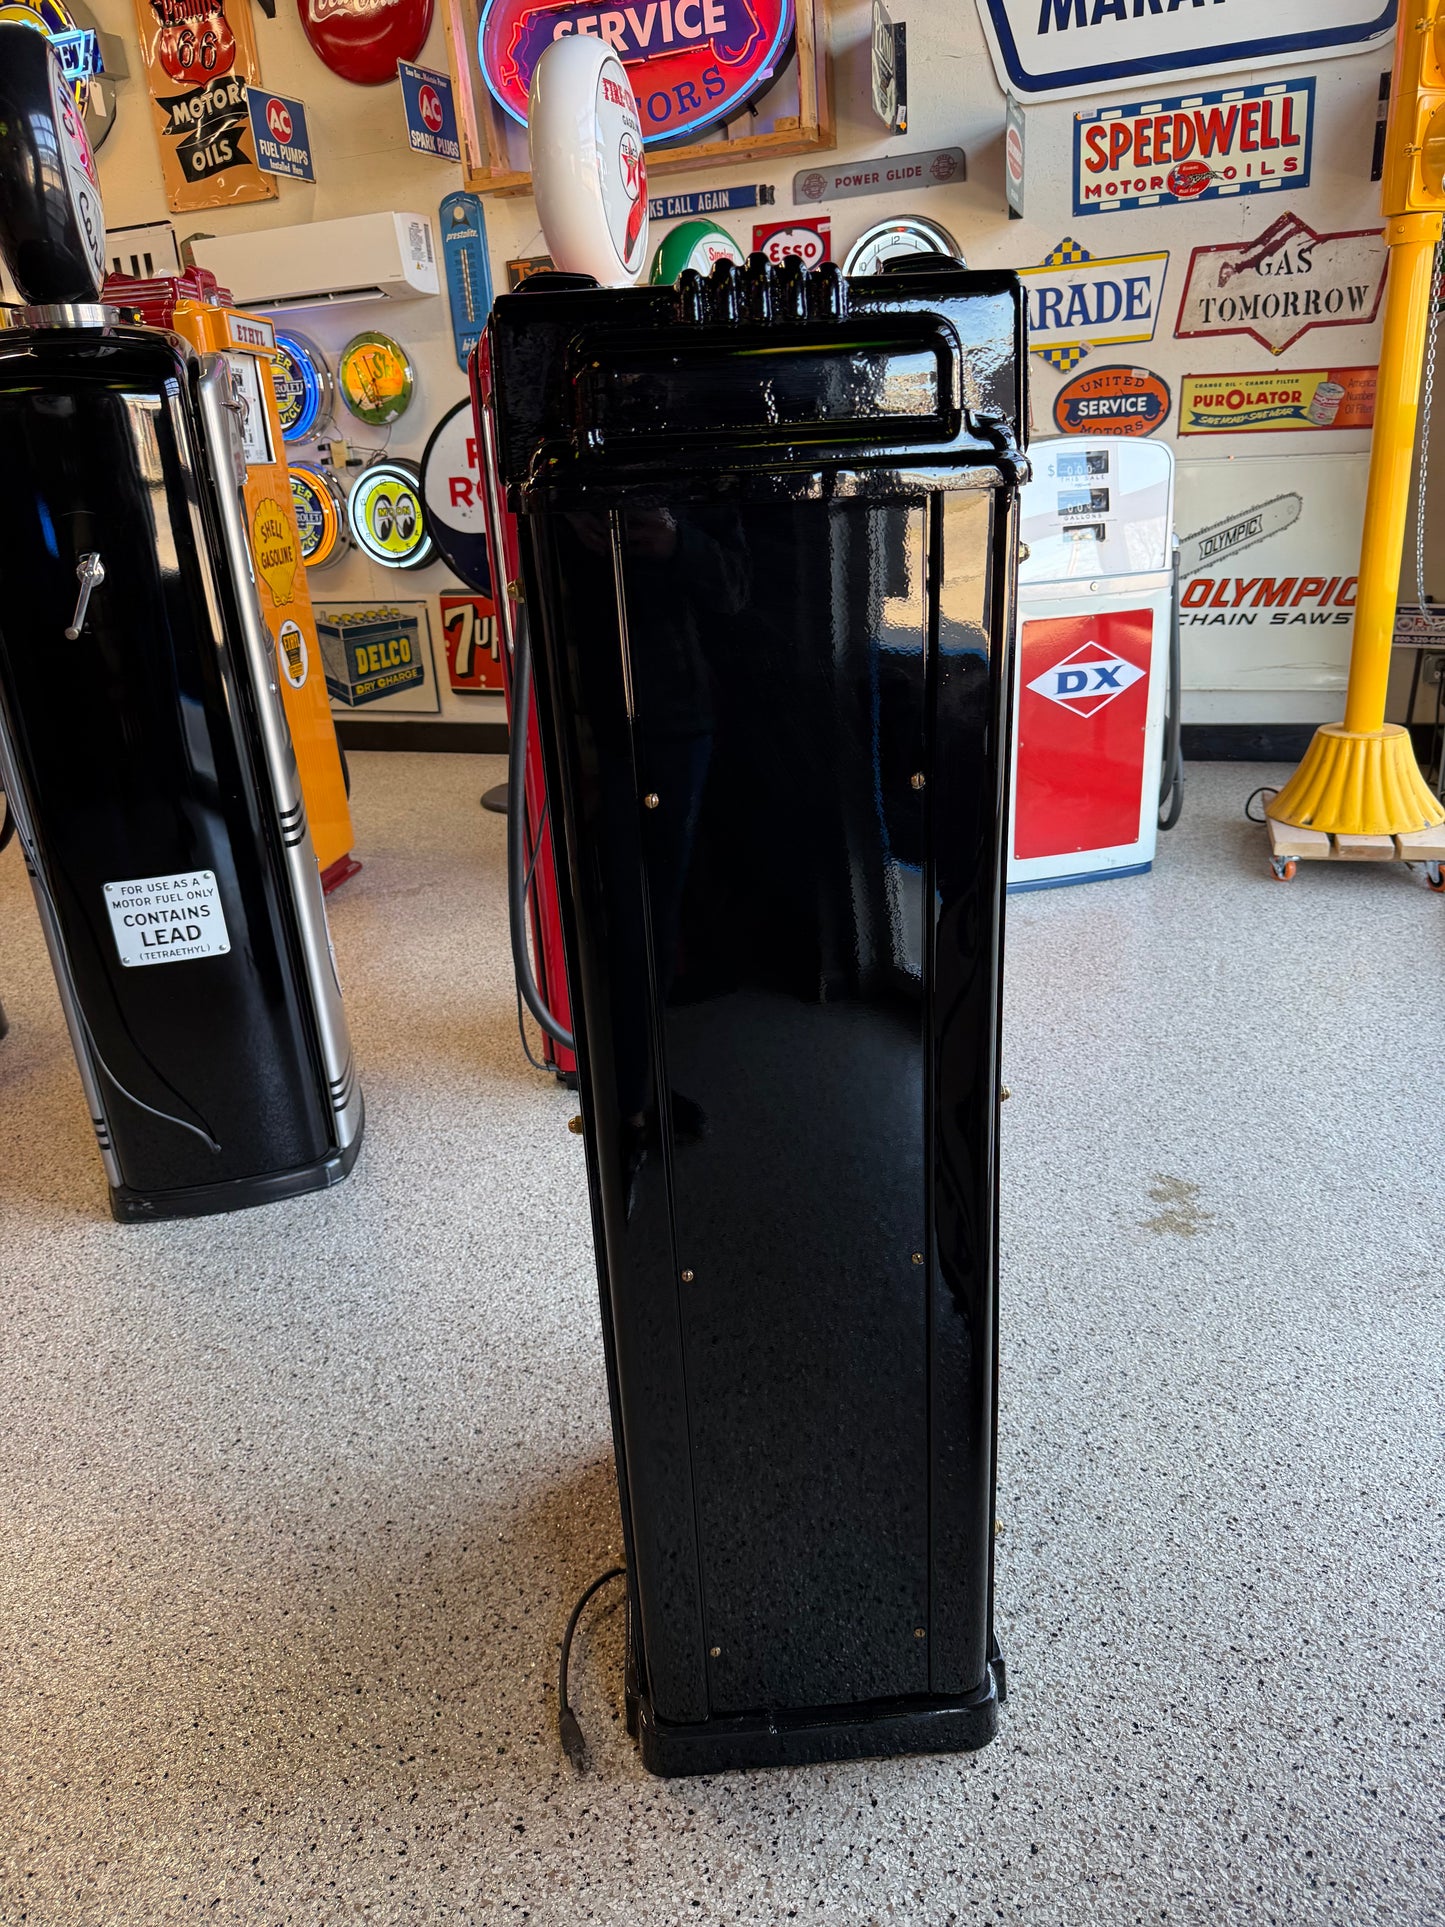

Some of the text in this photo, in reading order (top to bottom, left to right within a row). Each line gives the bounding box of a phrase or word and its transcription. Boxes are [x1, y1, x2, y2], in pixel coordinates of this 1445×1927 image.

[177, 30, 219, 70] 66
[171, 84, 243, 126] MOTOR
[635, 65, 727, 122] ORS
[269, 107, 292, 135] AC
[421, 94, 443, 123] AC
[410, 130, 460, 157] SPARK PLUGS
[1083, 96, 1301, 174] SPEEDWELL
[192, 139, 234, 171] OILS
[258, 139, 310, 167] FUEL PUMPS
[270, 159, 304, 176] Installed Here
[835, 172, 880, 189] POWER
[886, 165, 923, 181] GLIDE
[1084, 156, 1299, 200] MOTOR OILS
[667, 196, 693, 216] CALL
[697, 190, 730, 211] AGAIN
[1255, 248, 1313, 277] GAS
[1199, 285, 1370, 323] TOMORROW
[236, 324, 266, 347] ETHYL
[1080, 375, 1145, 393] UNITED
[1194, 381, 1222, 389] CHANGE
[1245, 379, 1273, 387] CHANGE
[1077, 396, 1148, 416] SERVICE
[1193, 389, 1303, 410] PUROLATOR
[1080, 421, 1144, 436] MOTORS
[1047, 463, 1056, 478] $
[448, 477, 483, 507] R
[377, 505, 411, 518] MOON
[1063, 513, 1102, 522] GALLONS
[260, 519, 284, 544] SHELL
[1203, 517, 1258, 556] OLYMPIC
[260, 546, 294, 570] GASOLINE
[1180, 576, 1358, 608] OLYMPIC
[1269, 612, 1353, 625] SAWS
[354, 637, 411, 676] DELCO
[355, 668, 418, 695] DRY CHARGE
[1054, 664, 1126, 695] DX
[112, 888, 214, 909] MOTOR FUEL ONLY
[121, 878, 200, 896] FOR USE AS A
[123, 904, 211, 928] CONTAINS
[141, 925, 202, 947] LEAD
[139, 943, 212, 961] (TETRAETHYL)
